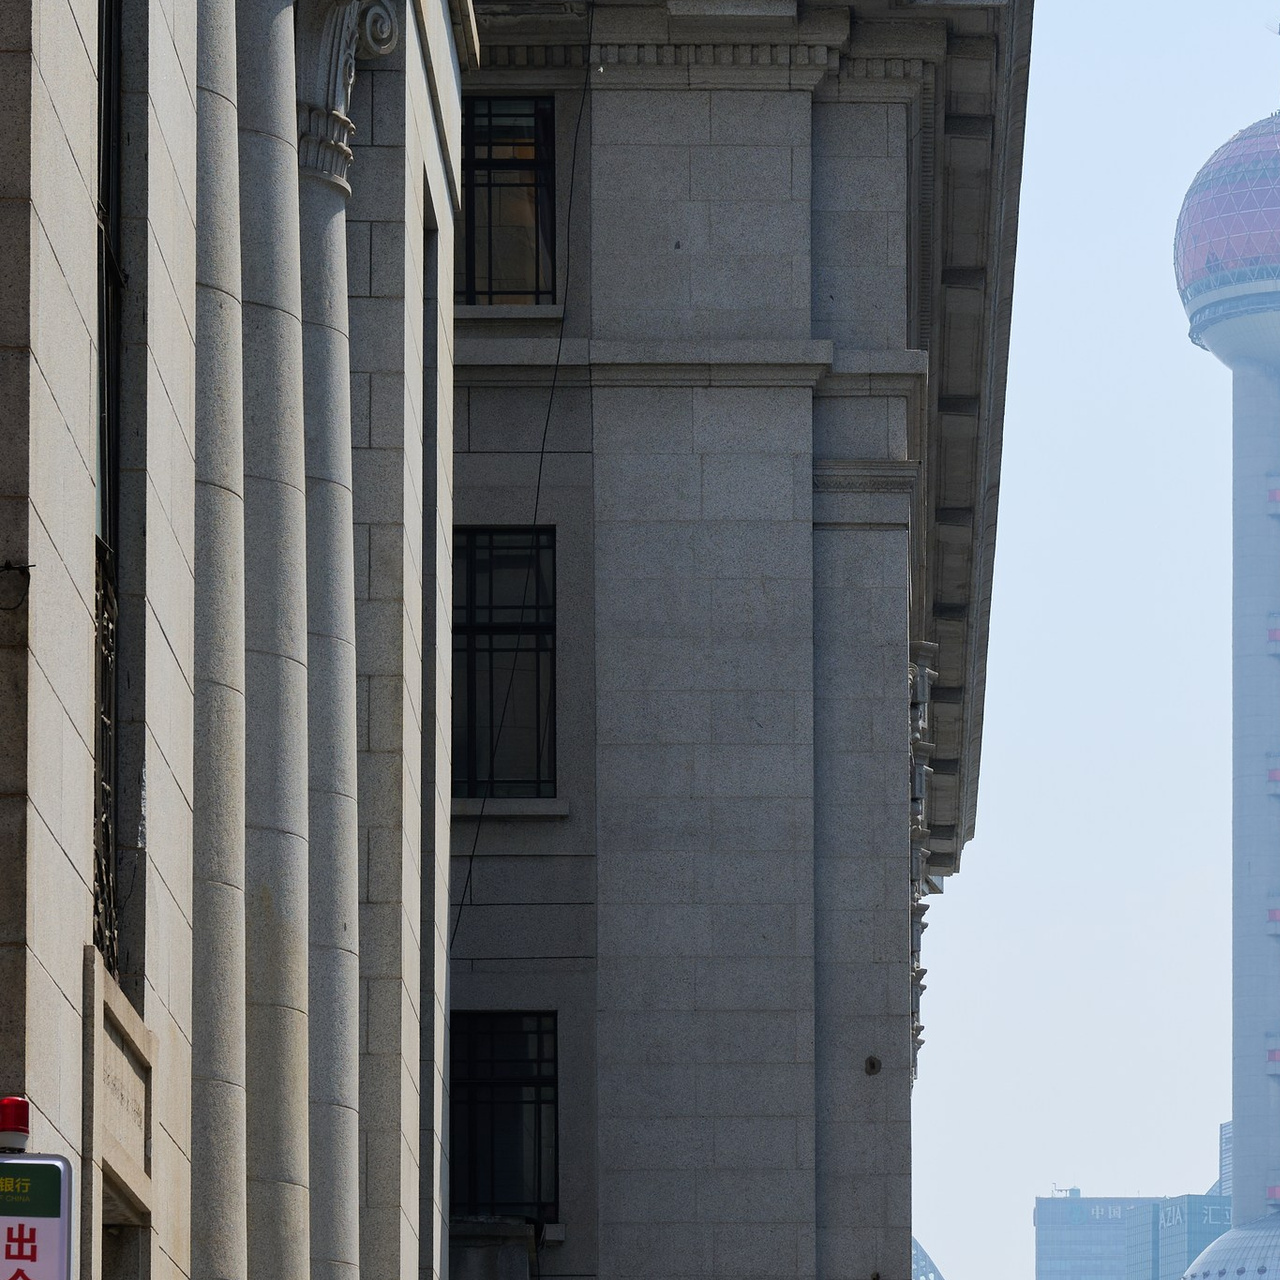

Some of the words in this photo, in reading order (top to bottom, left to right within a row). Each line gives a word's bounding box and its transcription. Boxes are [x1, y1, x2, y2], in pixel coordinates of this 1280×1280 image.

[1091, 1205, 1122, 1220] 中国
[1159, 1205, 1183, 1231] AZIA
[5, 1223, 38, 1263] 出
